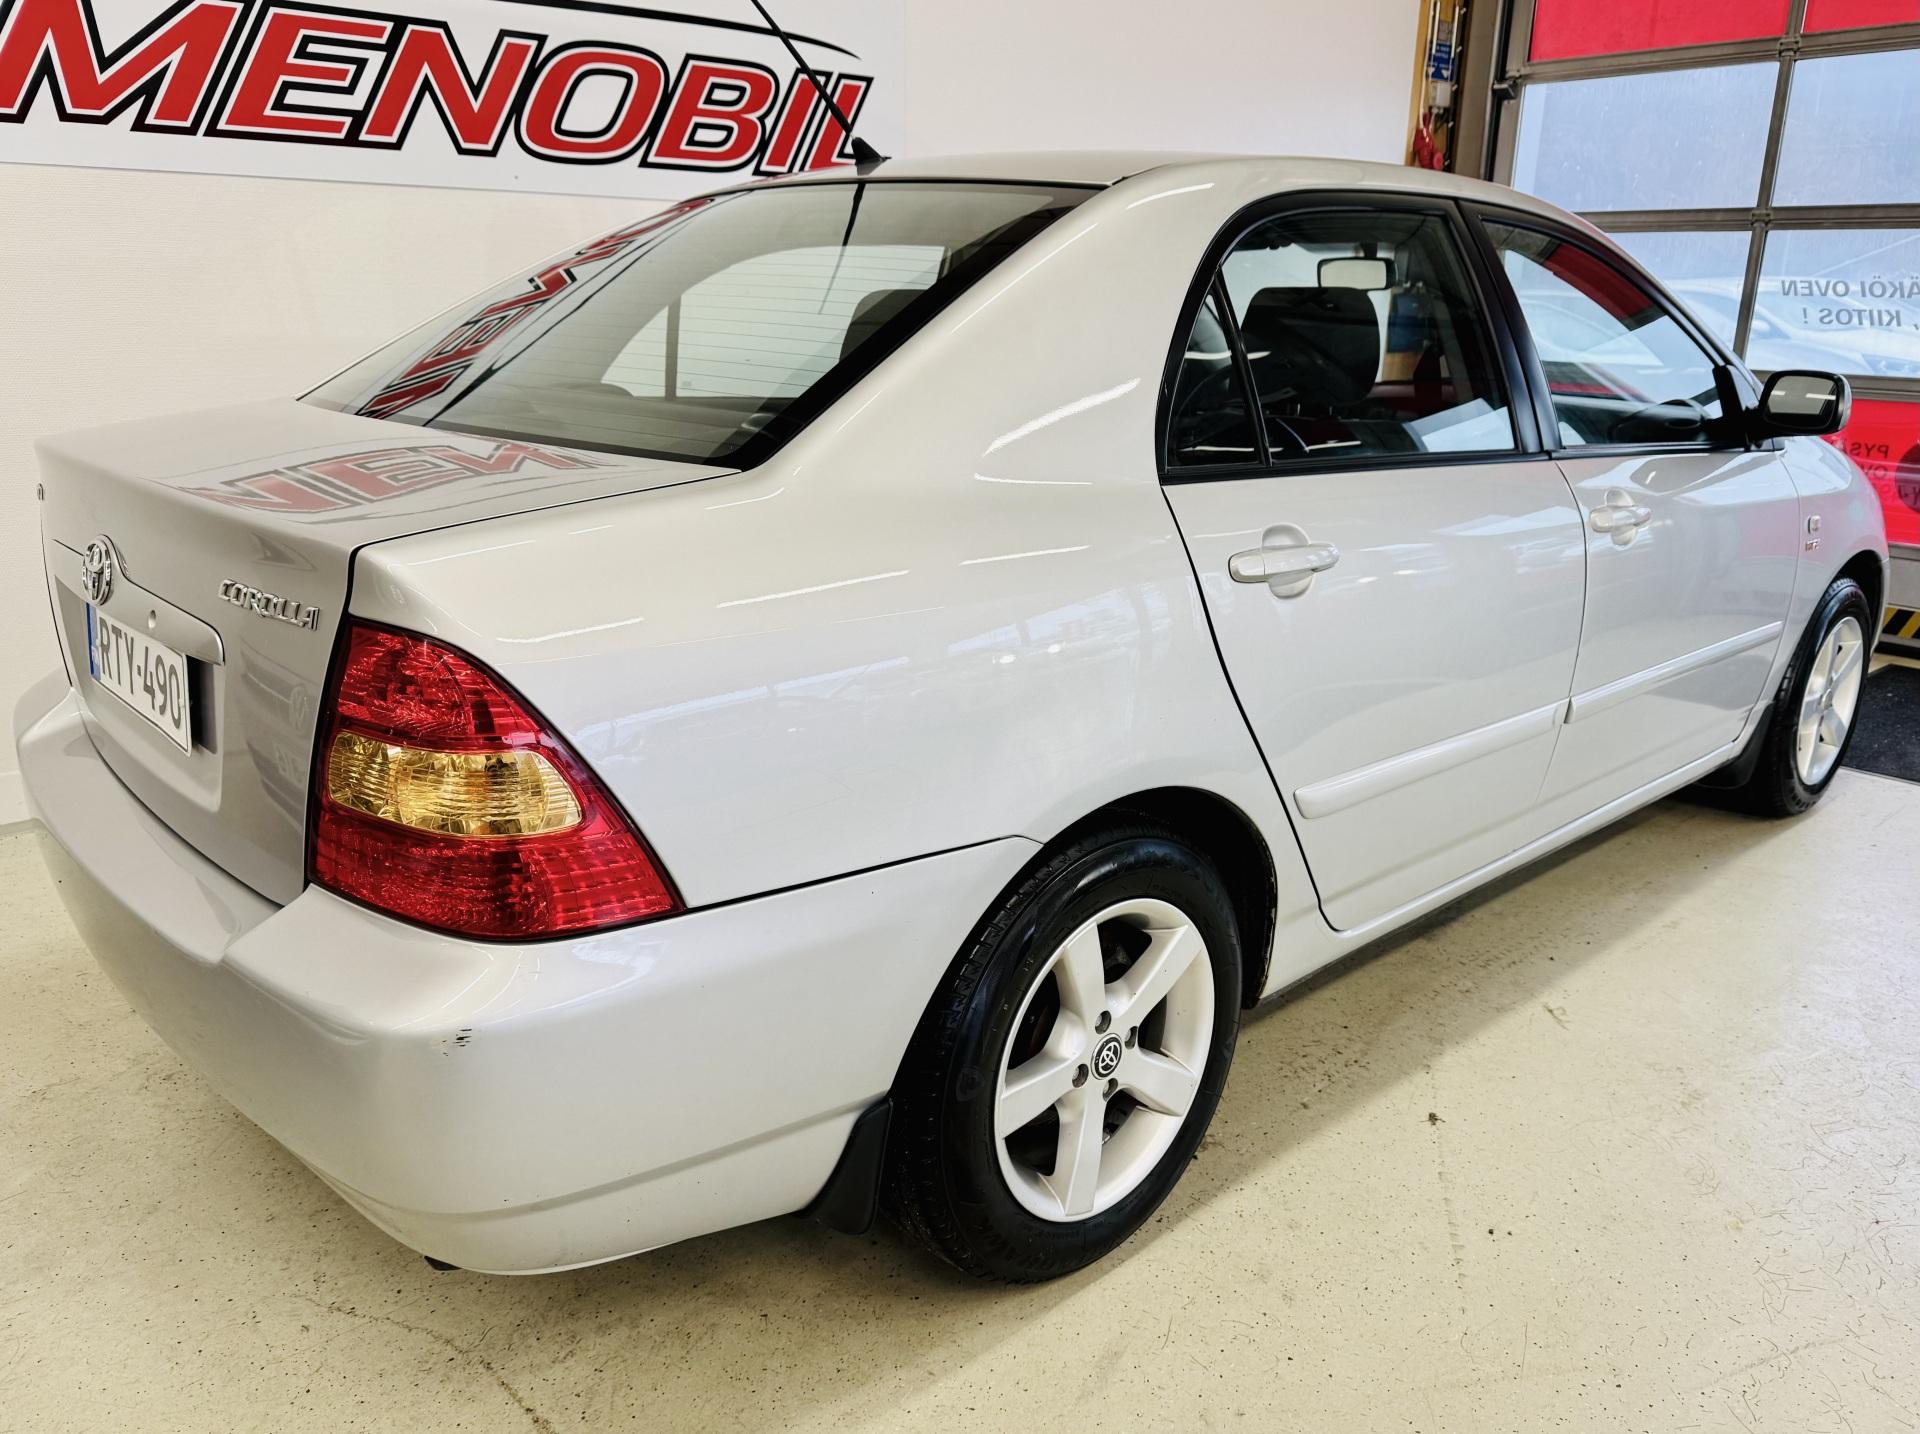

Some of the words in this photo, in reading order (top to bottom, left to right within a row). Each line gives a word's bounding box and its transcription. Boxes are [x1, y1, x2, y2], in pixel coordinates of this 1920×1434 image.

[0, 0, 874, 176] MENOBIL
[219, 579, 320, 630] COROLLA
[99, 616, 182, 730] RTY-490
